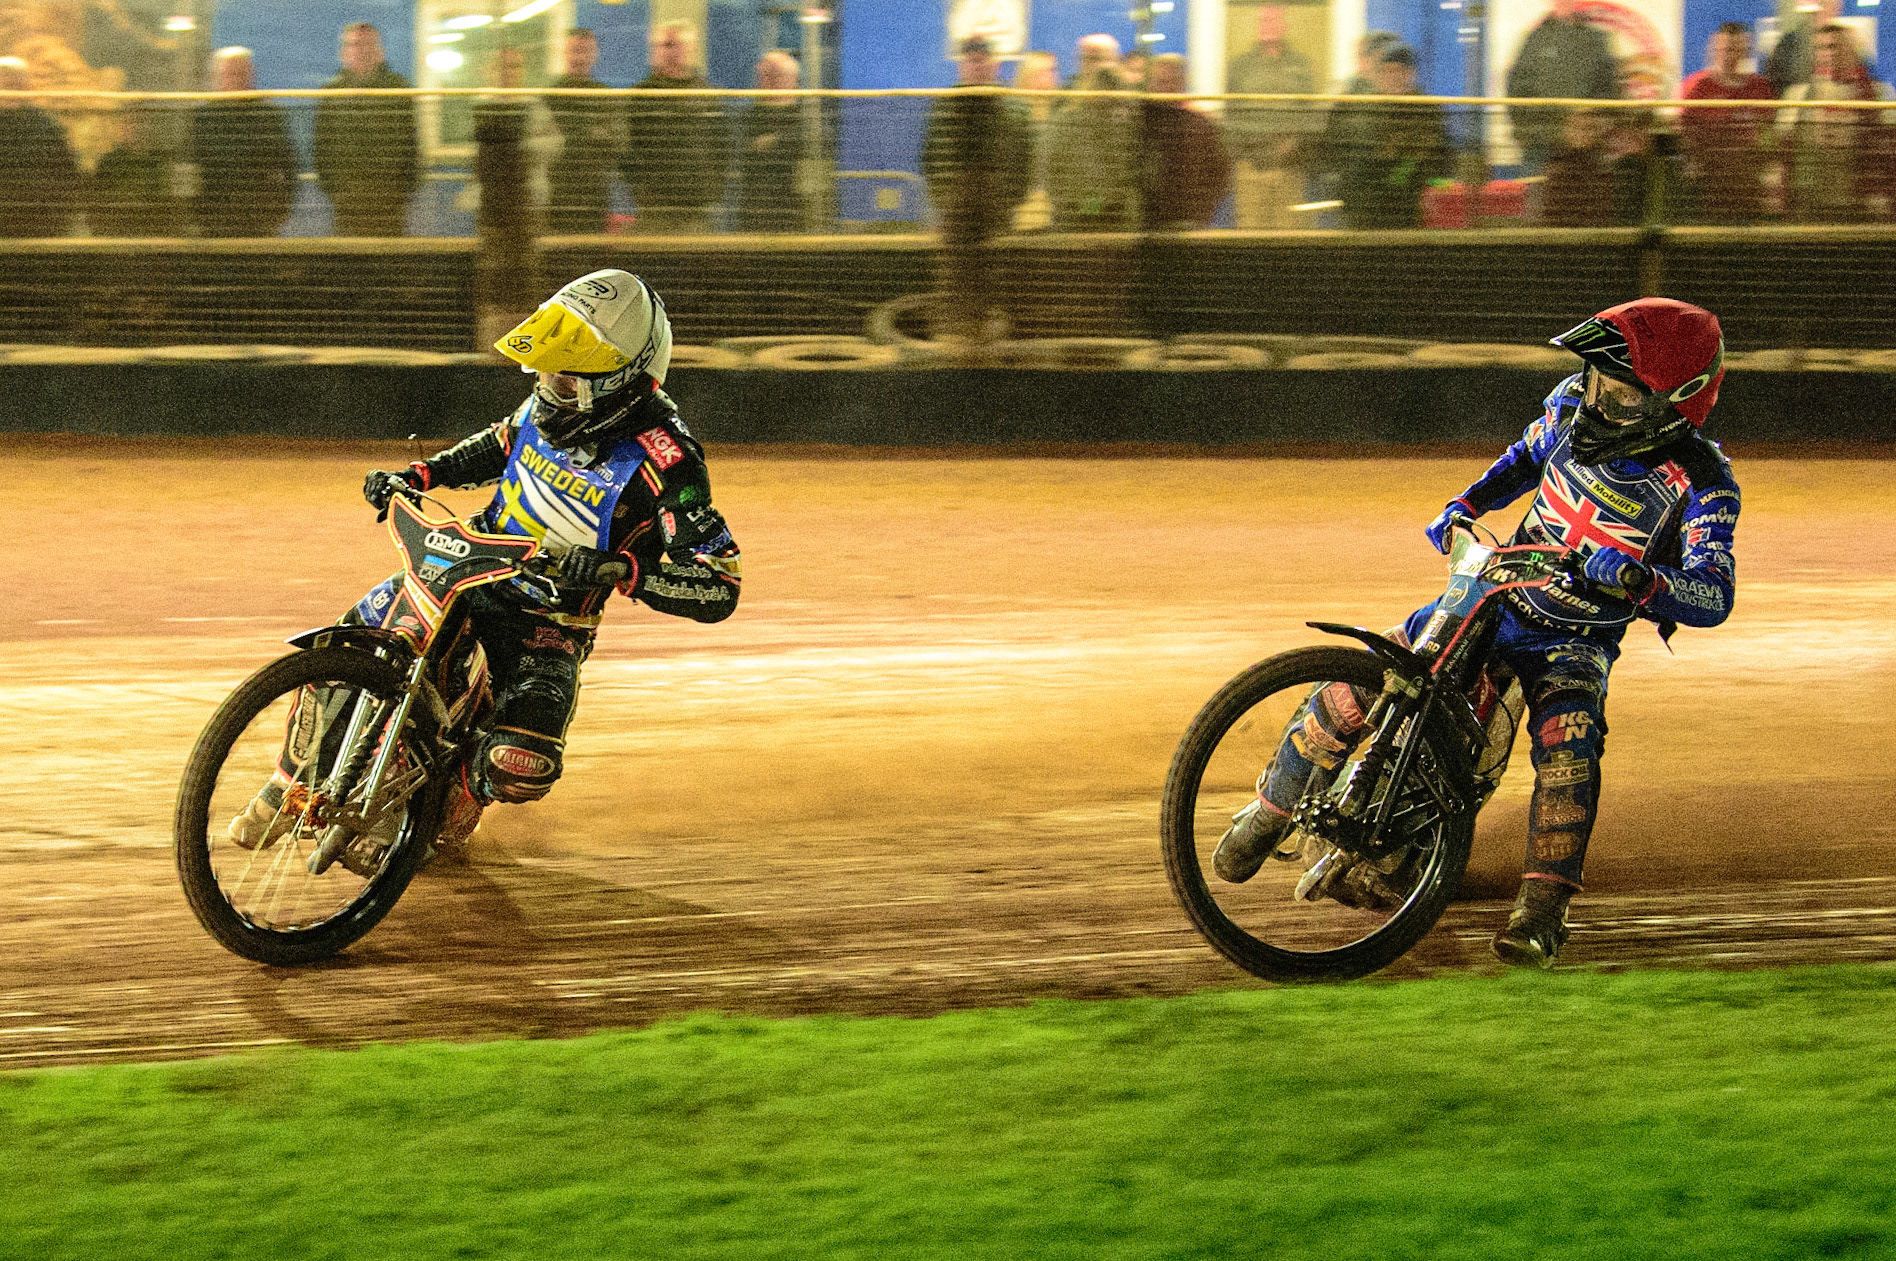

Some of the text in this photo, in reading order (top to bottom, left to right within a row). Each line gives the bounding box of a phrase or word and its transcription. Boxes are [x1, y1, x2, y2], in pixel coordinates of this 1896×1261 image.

[577, 296, 597, 315] PARTS
[645, 428, 682, 463] NGK
[520, 444, 606, 507] SWEDEN
[1570, 461, 1594, 487] Allied
[1593, 482, 1640, 515] Mobility
[1541, 768, 1569, 781] ROCK
